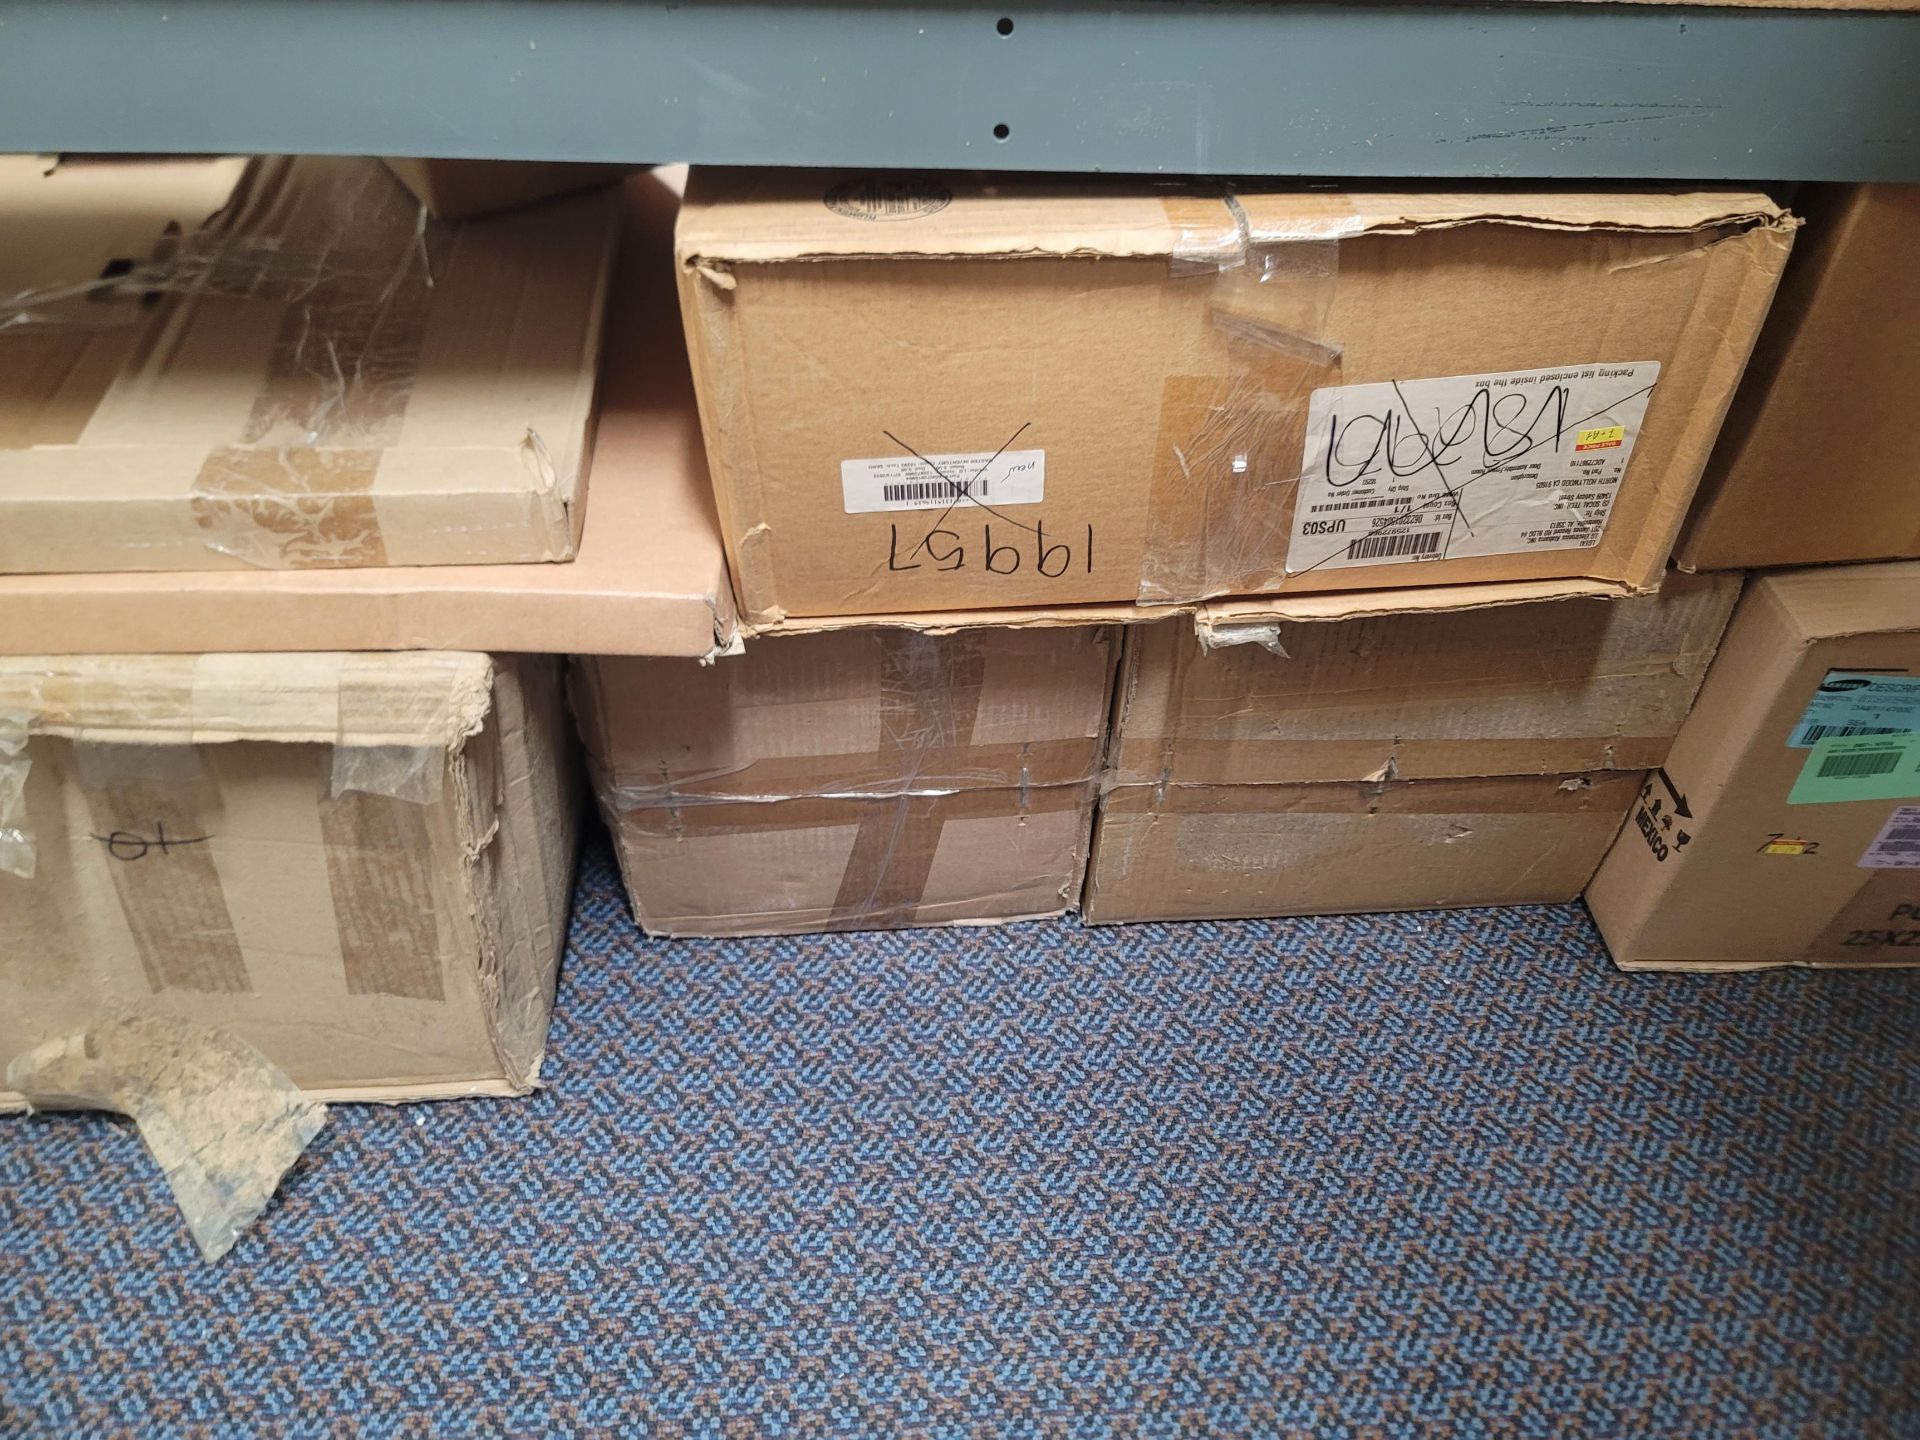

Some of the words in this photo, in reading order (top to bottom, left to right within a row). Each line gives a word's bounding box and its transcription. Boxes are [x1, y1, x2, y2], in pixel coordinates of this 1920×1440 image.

[1539, 372, 1578, 384] enclosed
[1582, 370, 1595, 380] list
[1598, 368, 1634, 378] Packing
[1474, 380, 1490, 388] box
[1494, 378, 1508, 388] the
[1510, 376, 1537, 386] inside
[1000, 460, 1036, 484] new
[1592, 468, 1602, 476] Part
[1553, 480, 1560, 488] CA
[1562, 478, 1597, 487] HOLLYWOOD
[1598, 476, 1618, 486] NORTH
[1352, 488, 1375, 496] Customer
[1558, 494, 1575, 502] Street
[1394, 504, 1412, 514] 1/1
[1583, 500, 1600, 508] SOCAL
[1594, 508, 1607, 517] Ship
[1302, 519, 1346, 536] UPS03
[1573, 527, 1590, 535] James
[1538, 535, 1560, 543] Alabama
[889, 519, 1092, 578] 19957
[1635, 806, 1669, 862] MEXICO
